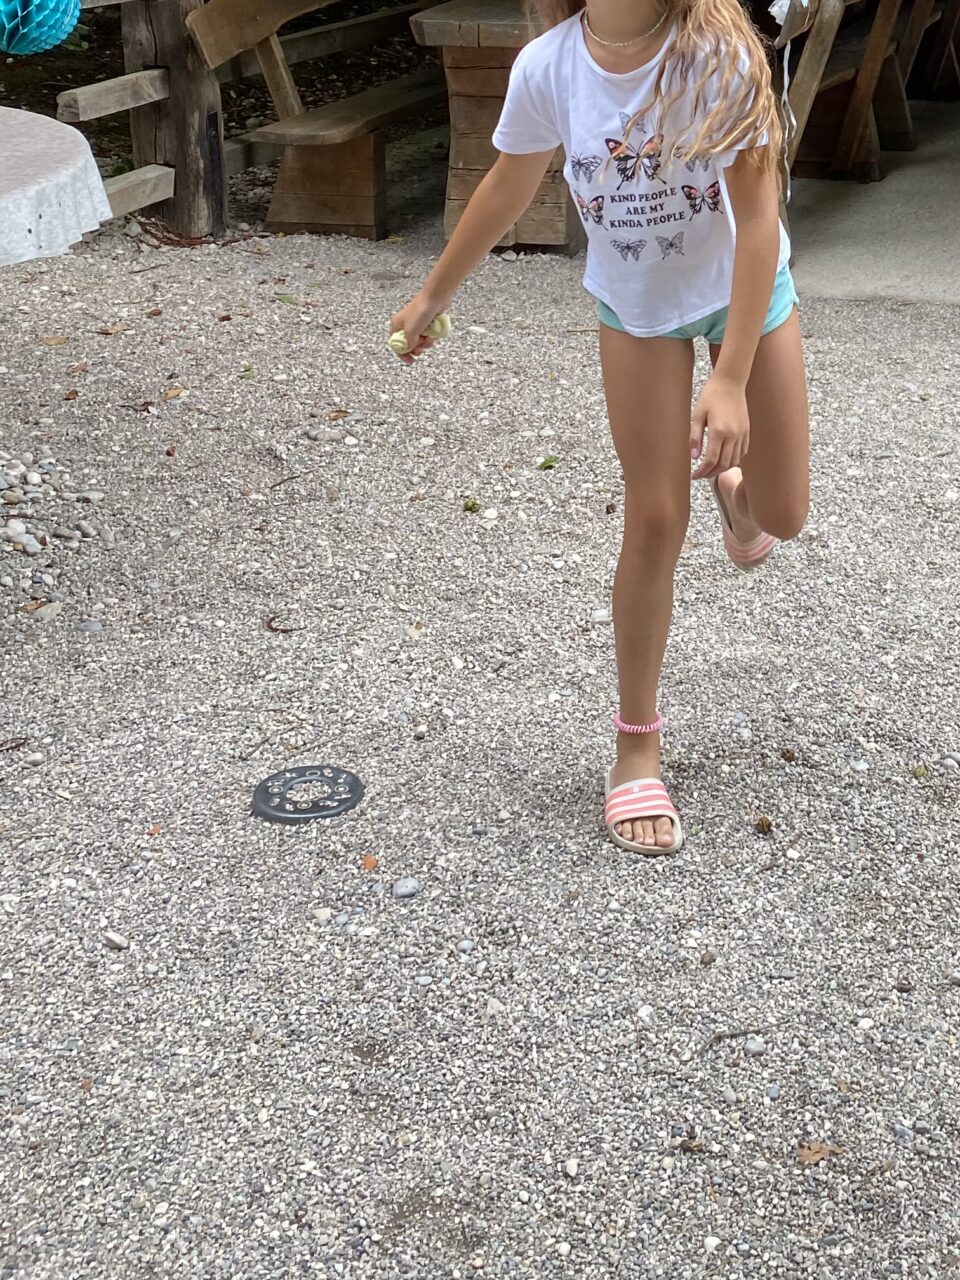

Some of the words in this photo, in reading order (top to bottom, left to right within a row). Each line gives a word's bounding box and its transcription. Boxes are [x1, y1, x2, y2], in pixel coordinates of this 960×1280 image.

[610, 194, 637, 203] KIND
[638, 187, 677, 202] PEOPLE
[626, 206, 647, 215] ARE
[649, 203, 665, 213] MY
[609, 220, 644, 228] KINDA
[646, 212, 686, 226] PEOPLE
